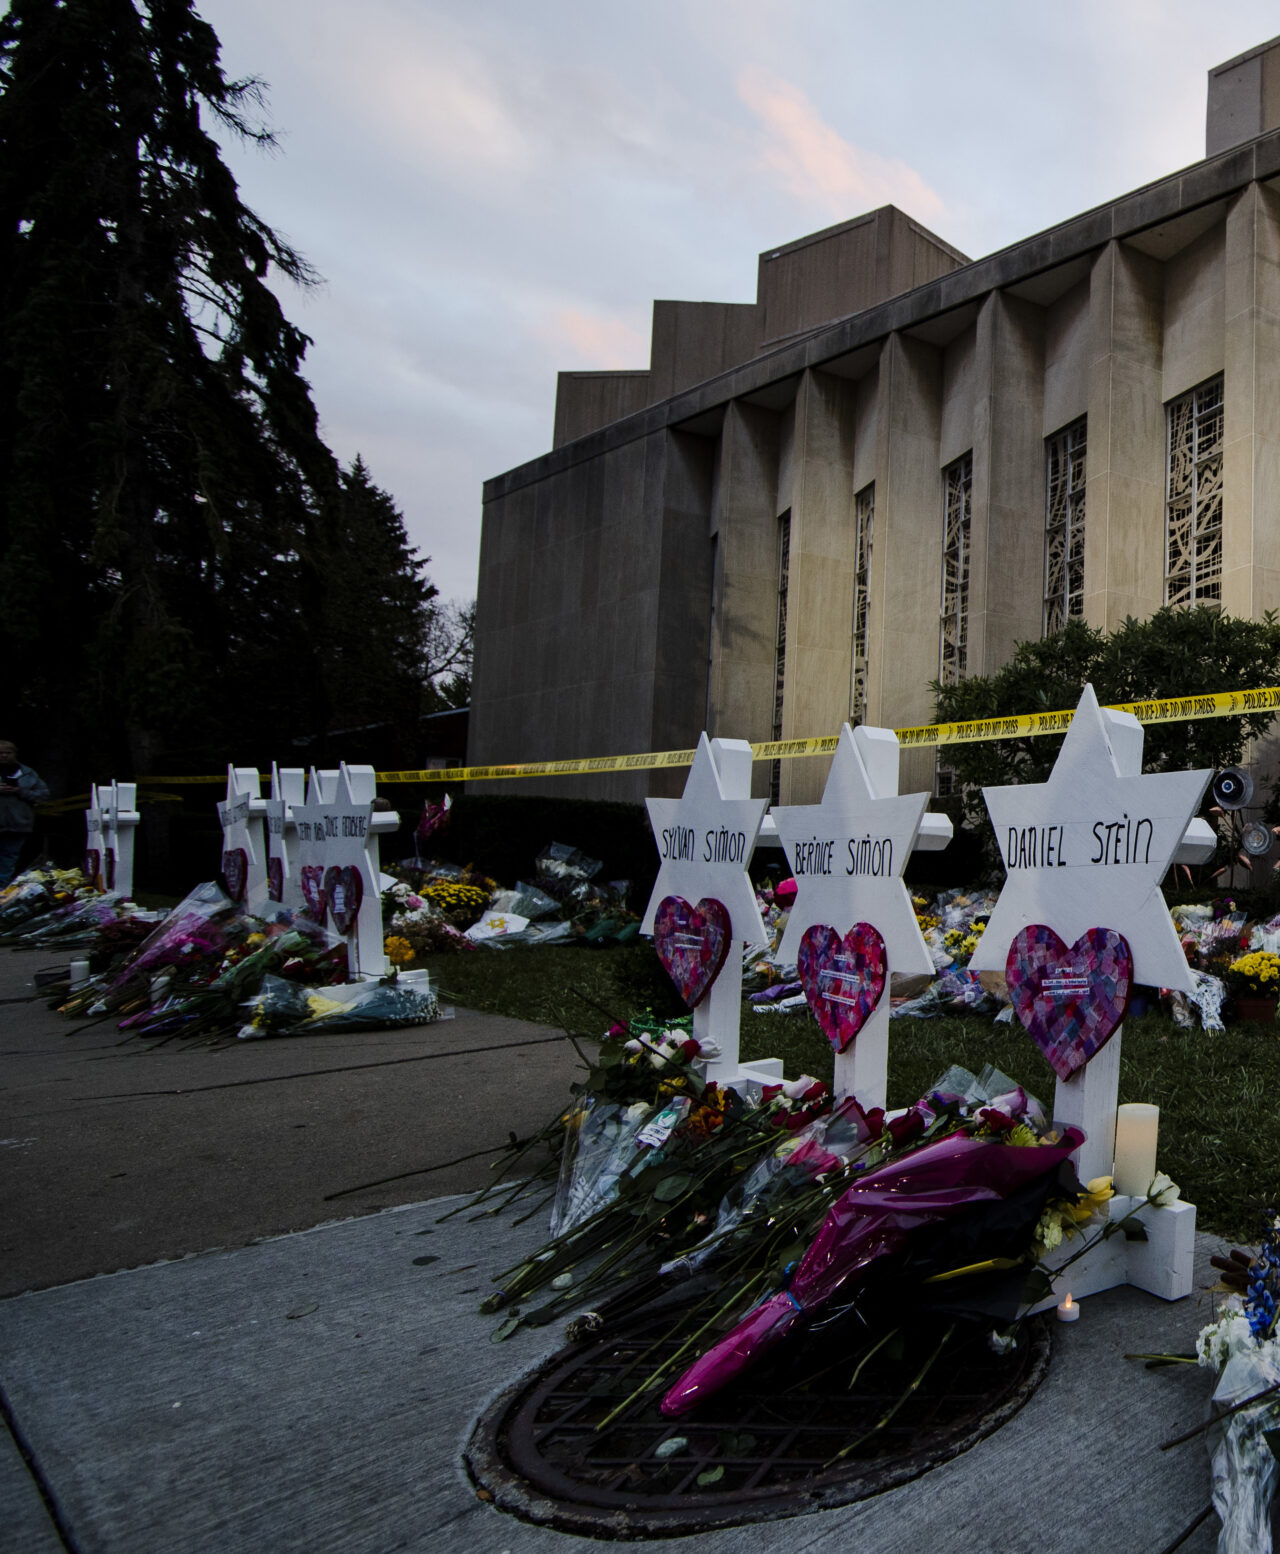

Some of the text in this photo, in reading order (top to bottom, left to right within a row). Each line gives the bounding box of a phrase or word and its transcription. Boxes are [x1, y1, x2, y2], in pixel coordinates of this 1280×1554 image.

[1133, 697, 1216, 721] POLICE LINE DO NOT CROSS
[1243, 692, 1268, 710] POLICE
[957, 719, 1019, 739] POLICE LINE DO NOT CROSS
[1039, 716, 1057, 731] POLICE
[1057, 714, 1070, 729] LINE
[662, 826, 746, 863] SYLVAN SIMON
[1008, 818, 1153, 869] DANIEL STEIN
[795, 838, 893, 877] BERNICE SIMON
